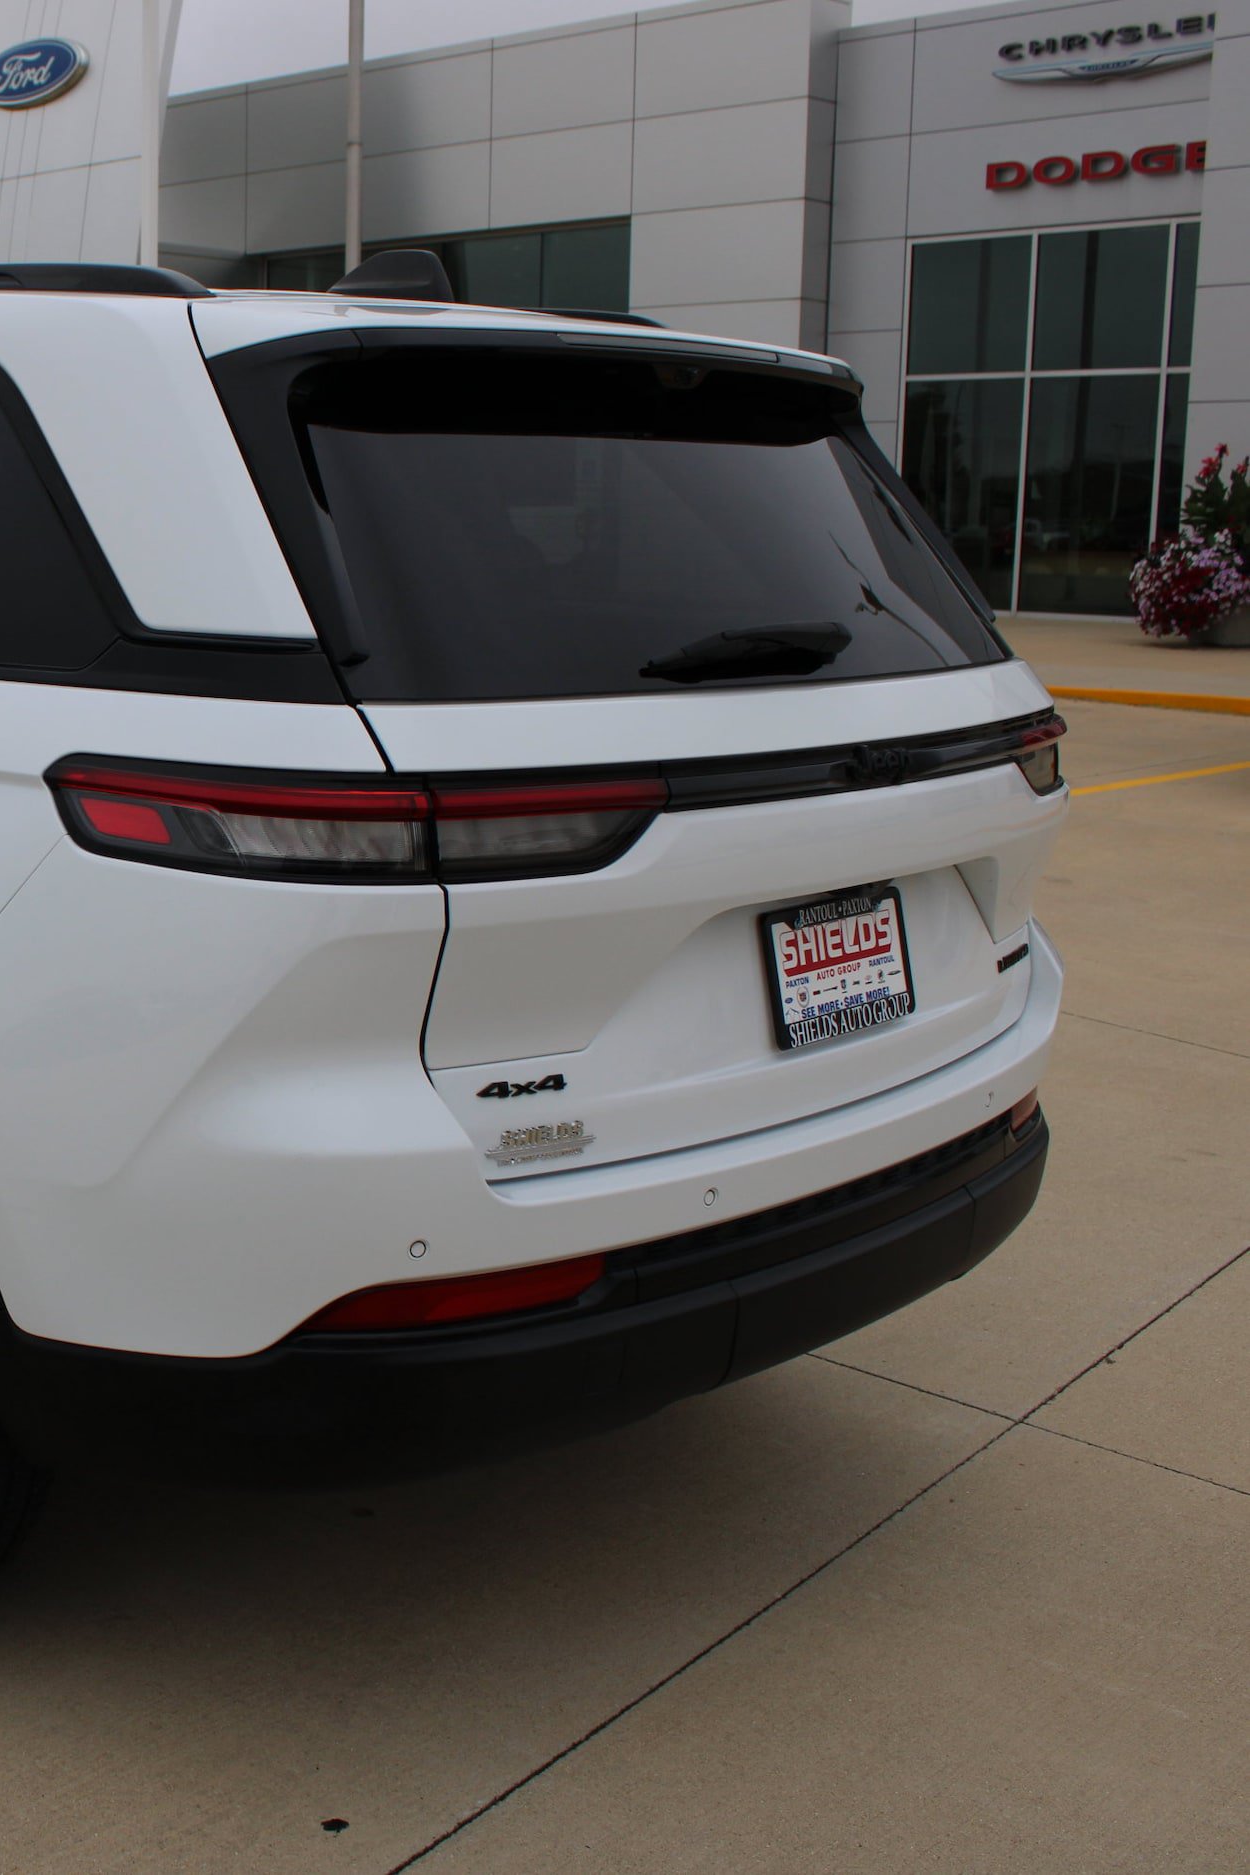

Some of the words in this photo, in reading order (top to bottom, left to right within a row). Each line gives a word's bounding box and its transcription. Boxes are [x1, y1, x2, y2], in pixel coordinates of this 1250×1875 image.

[799, 902, 838, 926] RANTOUL
[842, 897, 872, 916] PAXTON
[779, 908, 893, 971] SHIELDS
[816, 968, 835, 981] AUTO
[837, 961, 862, 975] GROUP
[869, 955, 895, 968] RANTOUL
[785, 976, 810, 989] PAXTON
[801, 1006, 816, 1019] SEE
[866, 986, 891, 1001] MORE!
[476, 1073, 568, 1099] 4x4
